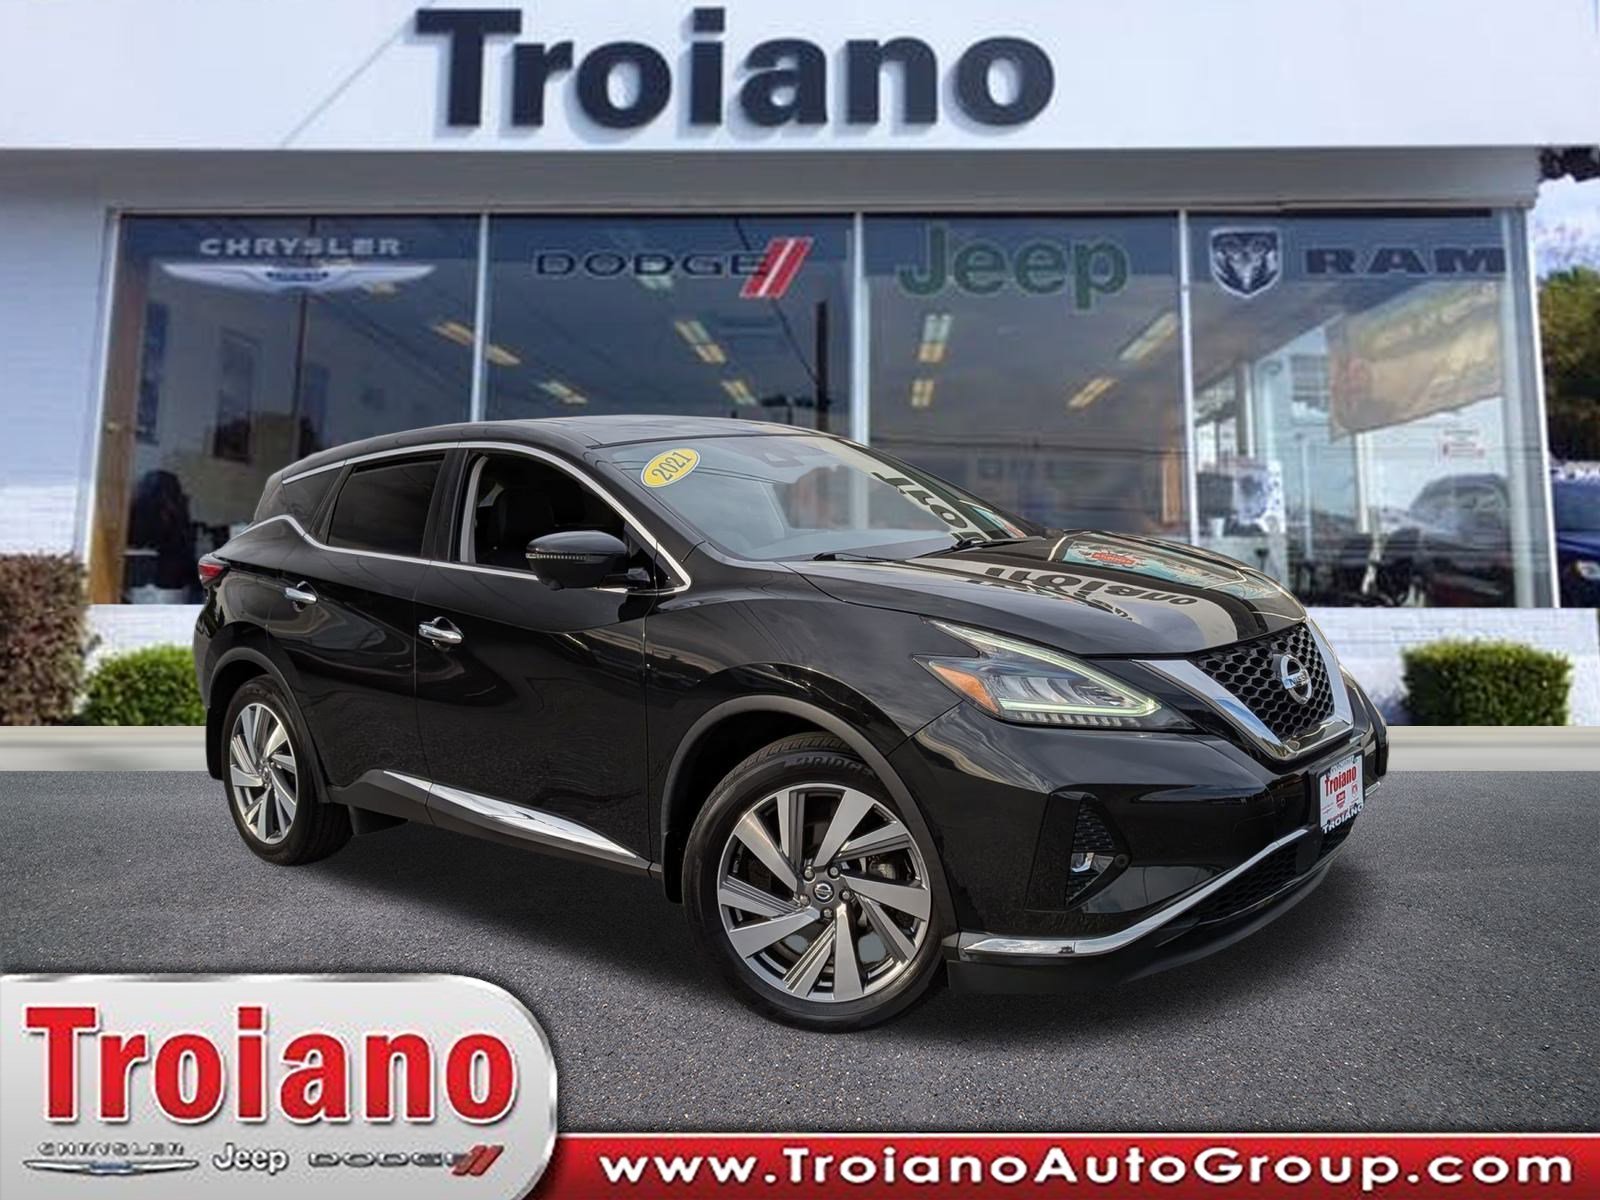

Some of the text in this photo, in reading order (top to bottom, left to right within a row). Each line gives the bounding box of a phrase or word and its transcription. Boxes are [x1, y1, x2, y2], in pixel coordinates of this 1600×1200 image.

[416, 8, 1055, 128] Troiano
[200, 237, 401, 256] CHRYSLER
[1306, 247, 1505, 274] RAM
[536, 252, 768, 277] DODGE
[900, 225, 1128, 309] Jeep
[651, 451, 692, 481] 2021
[1324, 765, 1357, 798] Troiano
[1321, 802, 1364, 835] TROIANO
